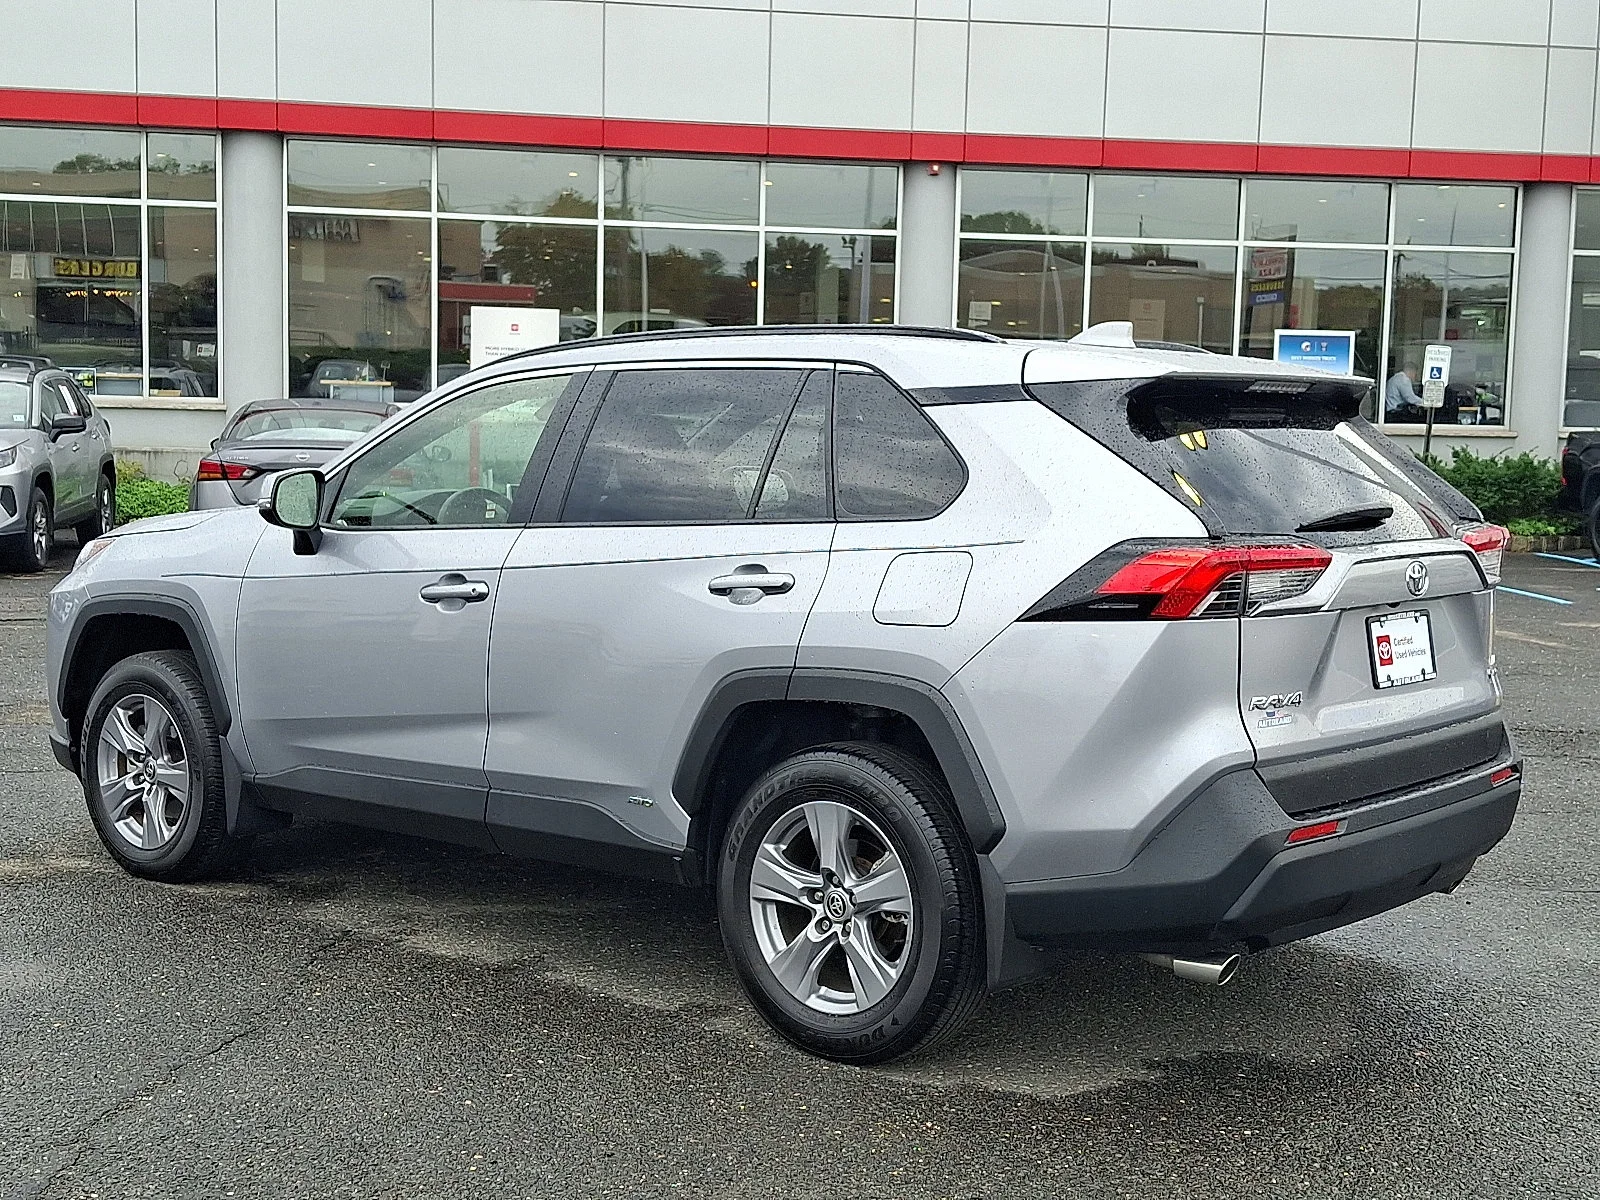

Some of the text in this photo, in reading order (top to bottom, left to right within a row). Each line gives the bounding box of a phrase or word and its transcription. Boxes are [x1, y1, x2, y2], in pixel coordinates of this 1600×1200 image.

[1393, 635, 1414, 647] Certified
[1394, 647, 1427, 660] Used Vehicles
[1248, 690, 1303, 711] RAV4
[1257, 716, 1292, 729] AUTOLAND
